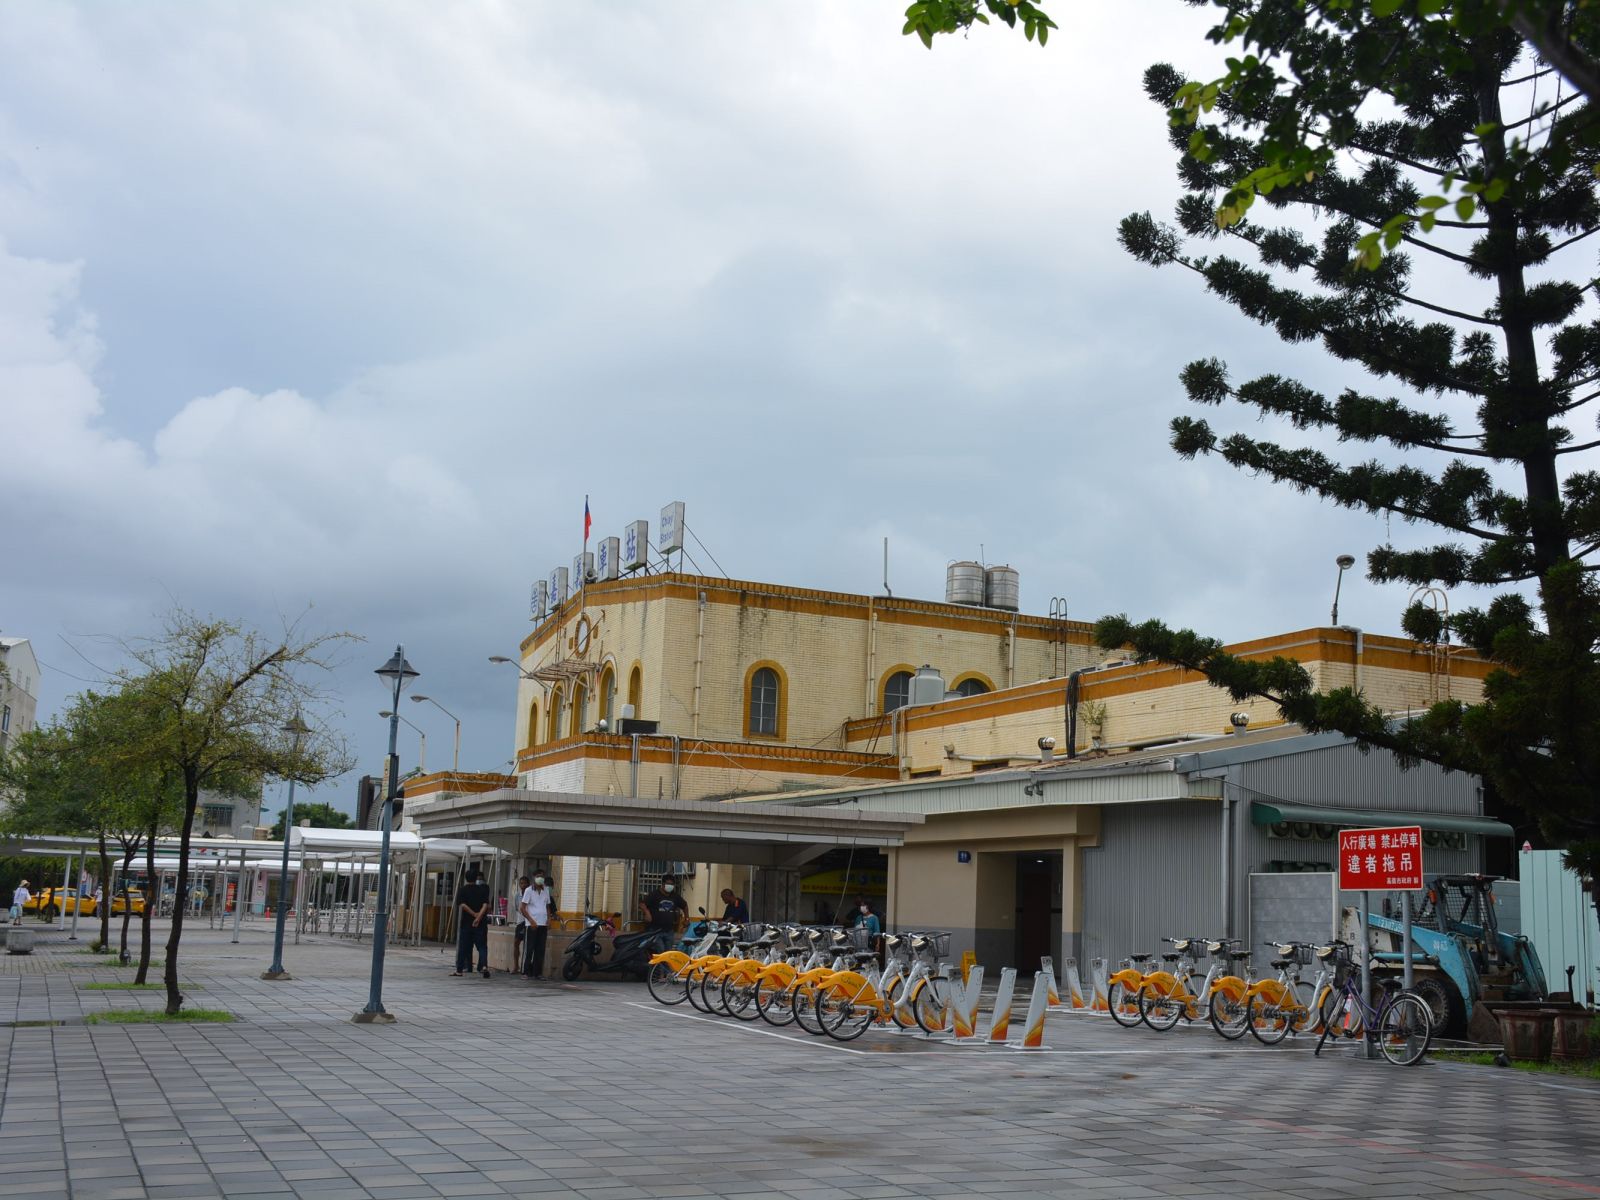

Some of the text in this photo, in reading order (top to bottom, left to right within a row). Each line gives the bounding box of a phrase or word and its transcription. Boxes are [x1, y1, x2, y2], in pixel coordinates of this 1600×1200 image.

[1342, 832, 1418, 850] 人行廣場 禁止停車
[1348, 852, 1413, 873] 違者拖吊
